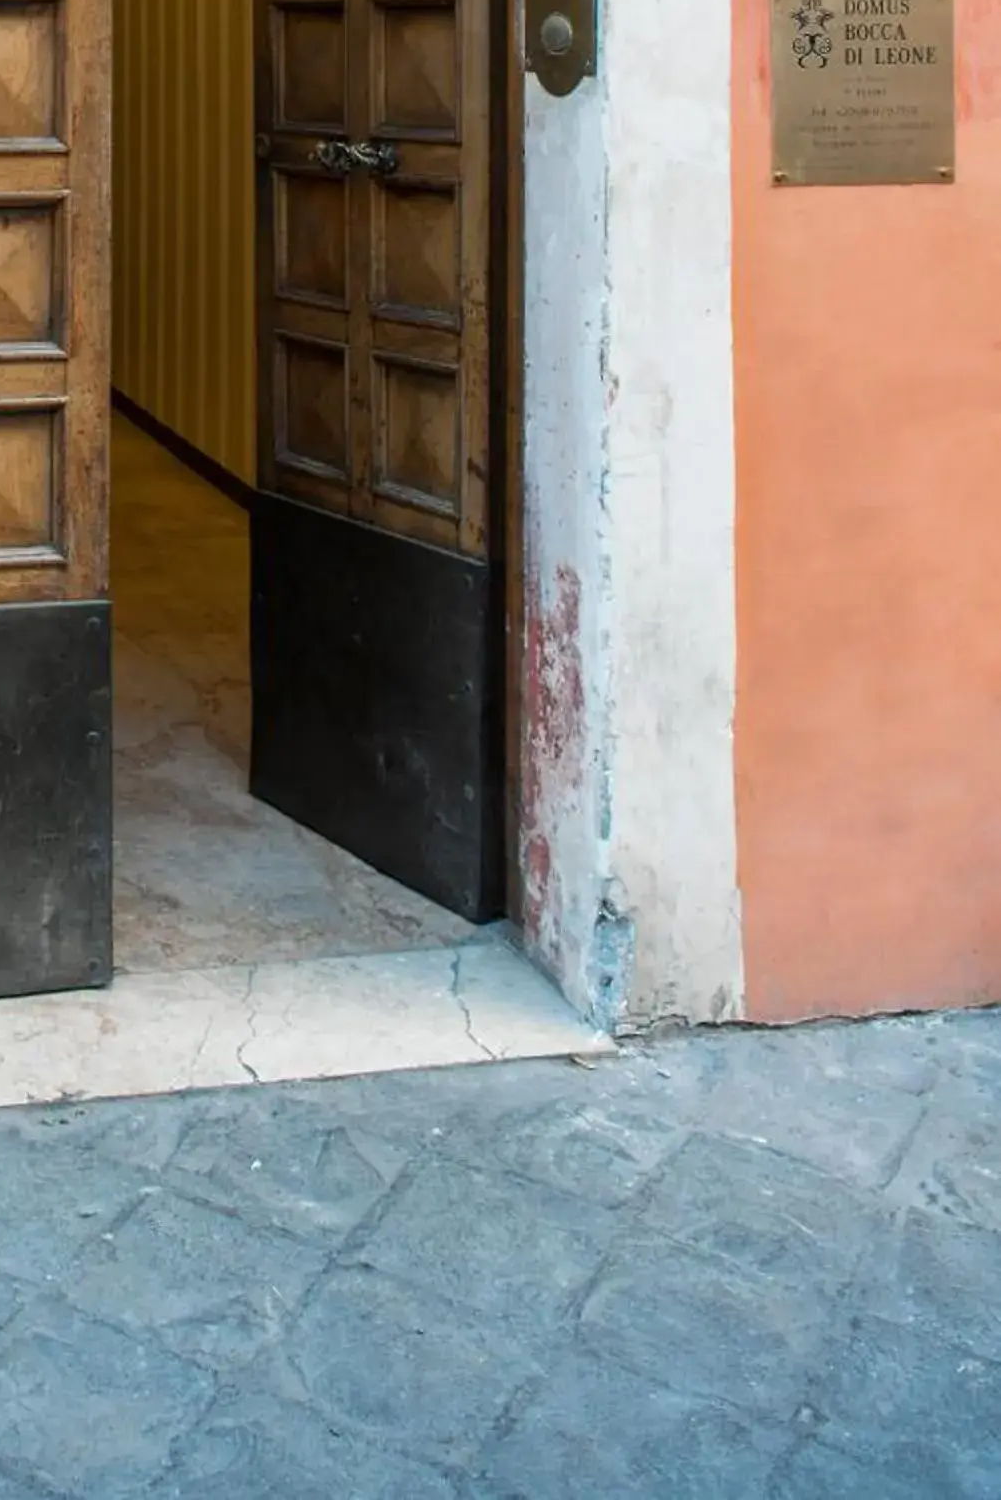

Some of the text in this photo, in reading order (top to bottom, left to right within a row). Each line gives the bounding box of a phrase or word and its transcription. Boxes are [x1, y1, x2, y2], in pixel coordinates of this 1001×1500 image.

[845, 24, 907, 41] BOCCA
[845, 47, 937, 66] DI LEONE
